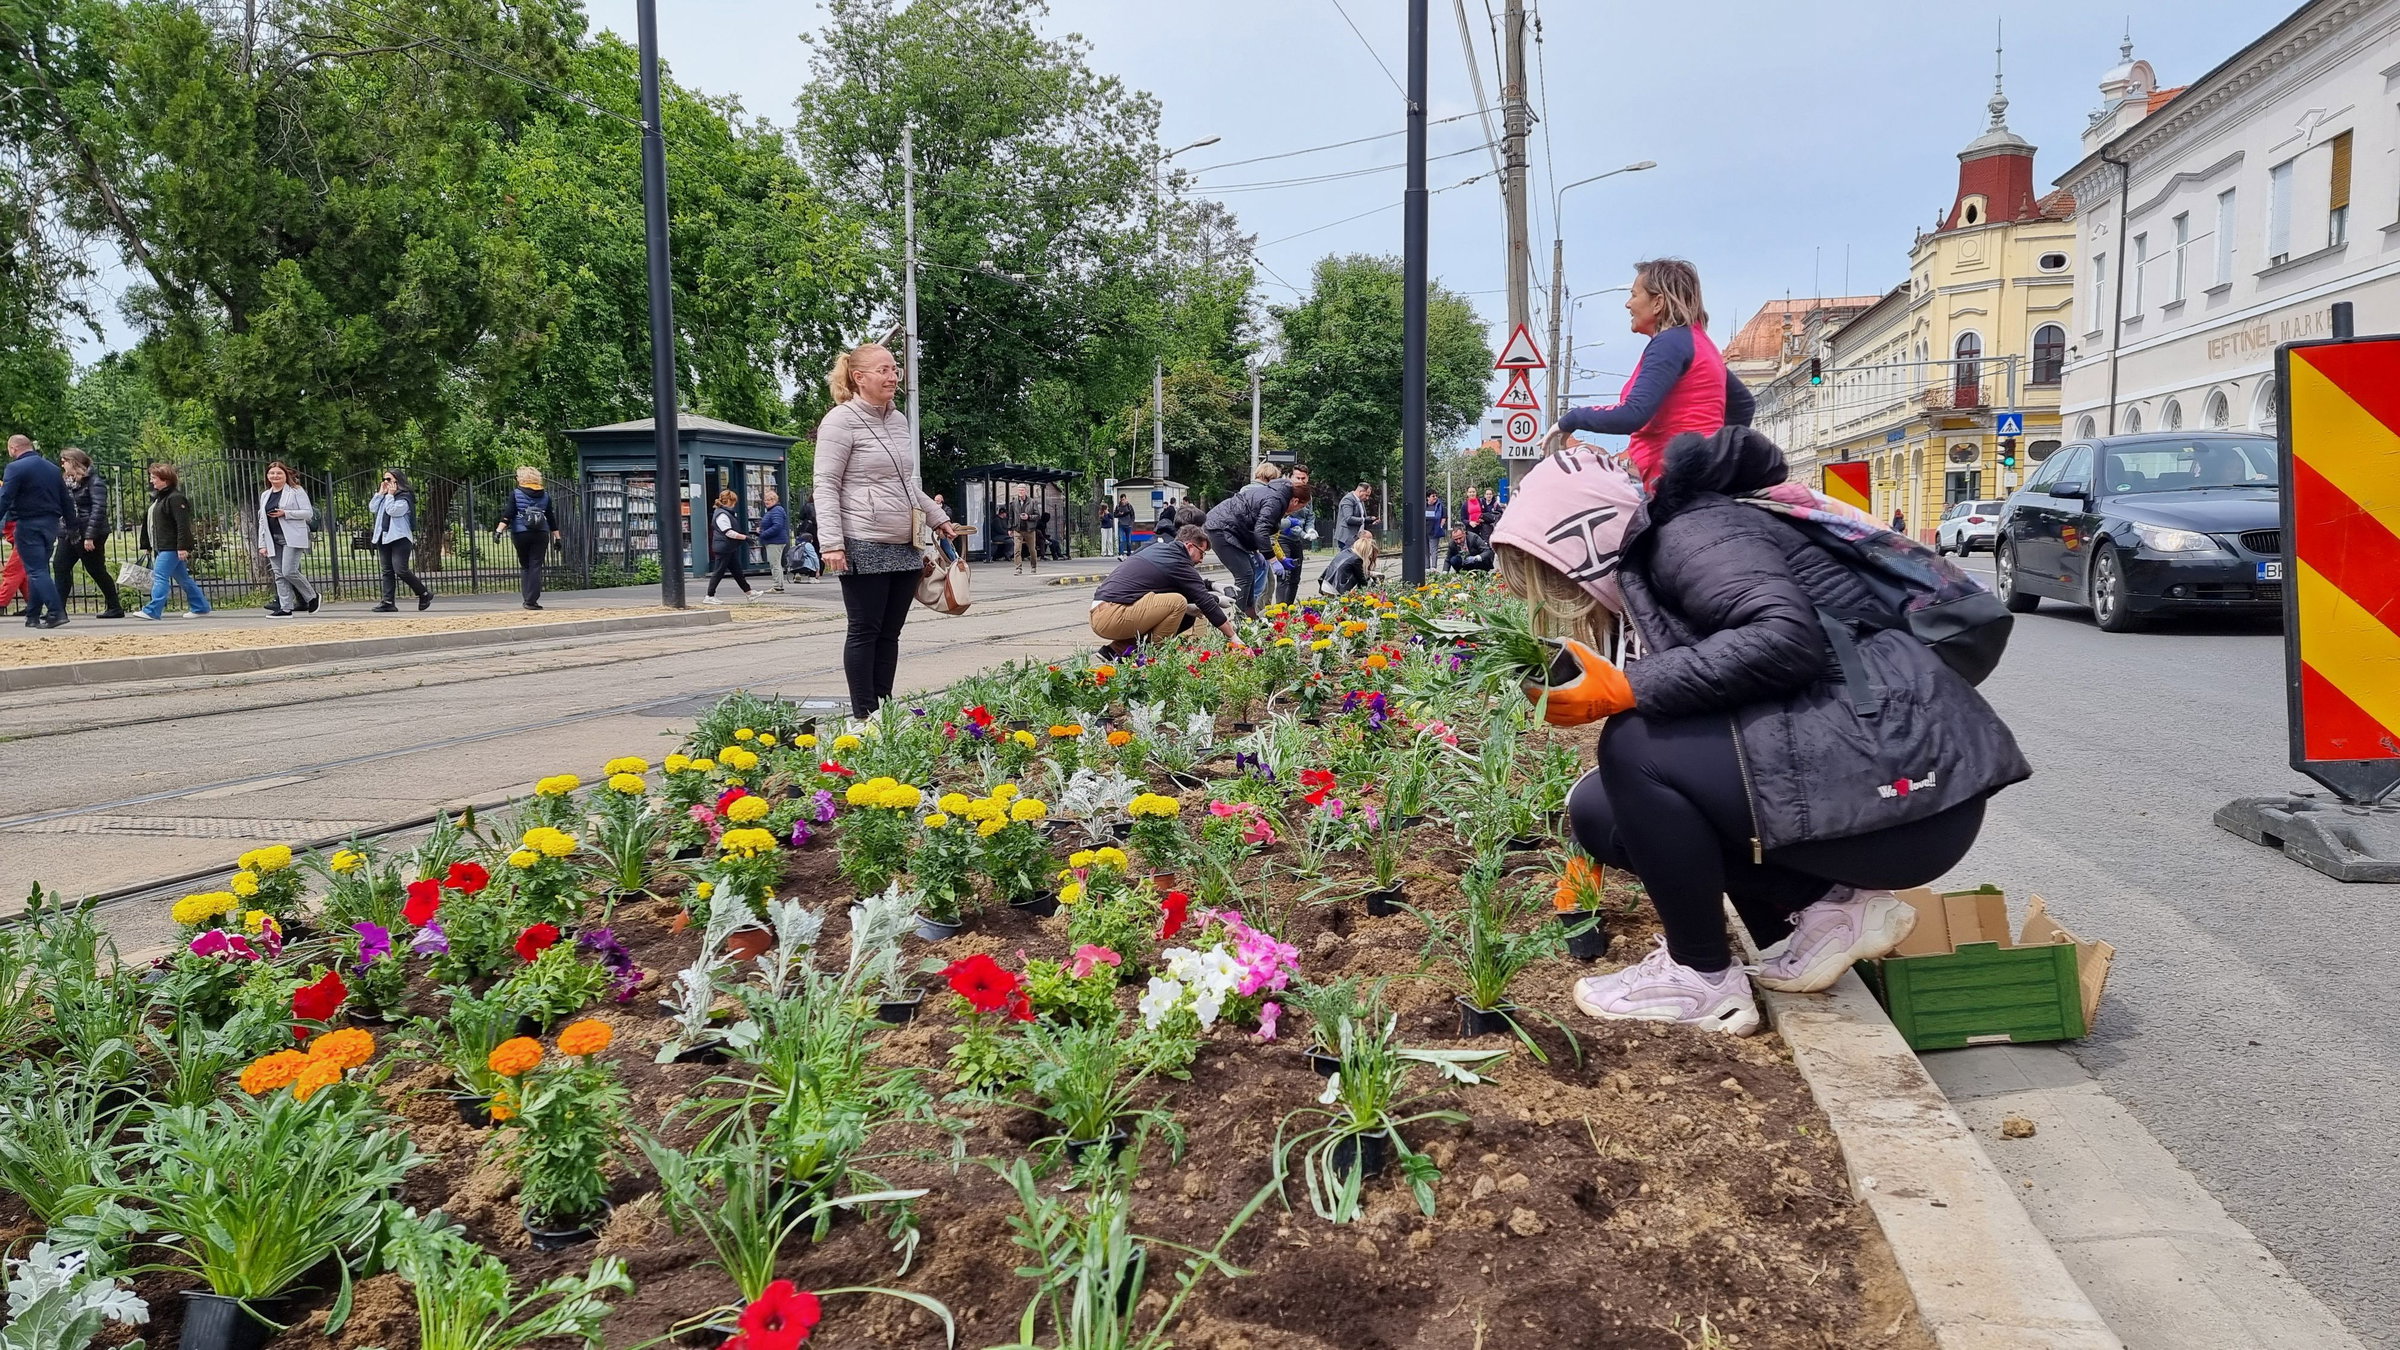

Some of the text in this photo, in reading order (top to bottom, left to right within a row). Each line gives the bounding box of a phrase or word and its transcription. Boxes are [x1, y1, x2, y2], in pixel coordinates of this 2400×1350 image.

[2207, 324, 2276, 360] IEFTINEL
[1513, 420, 1531, 435] 30
[1508, 446, 1535, 457] ZONA
[1877, 784, 1898, 799] We
